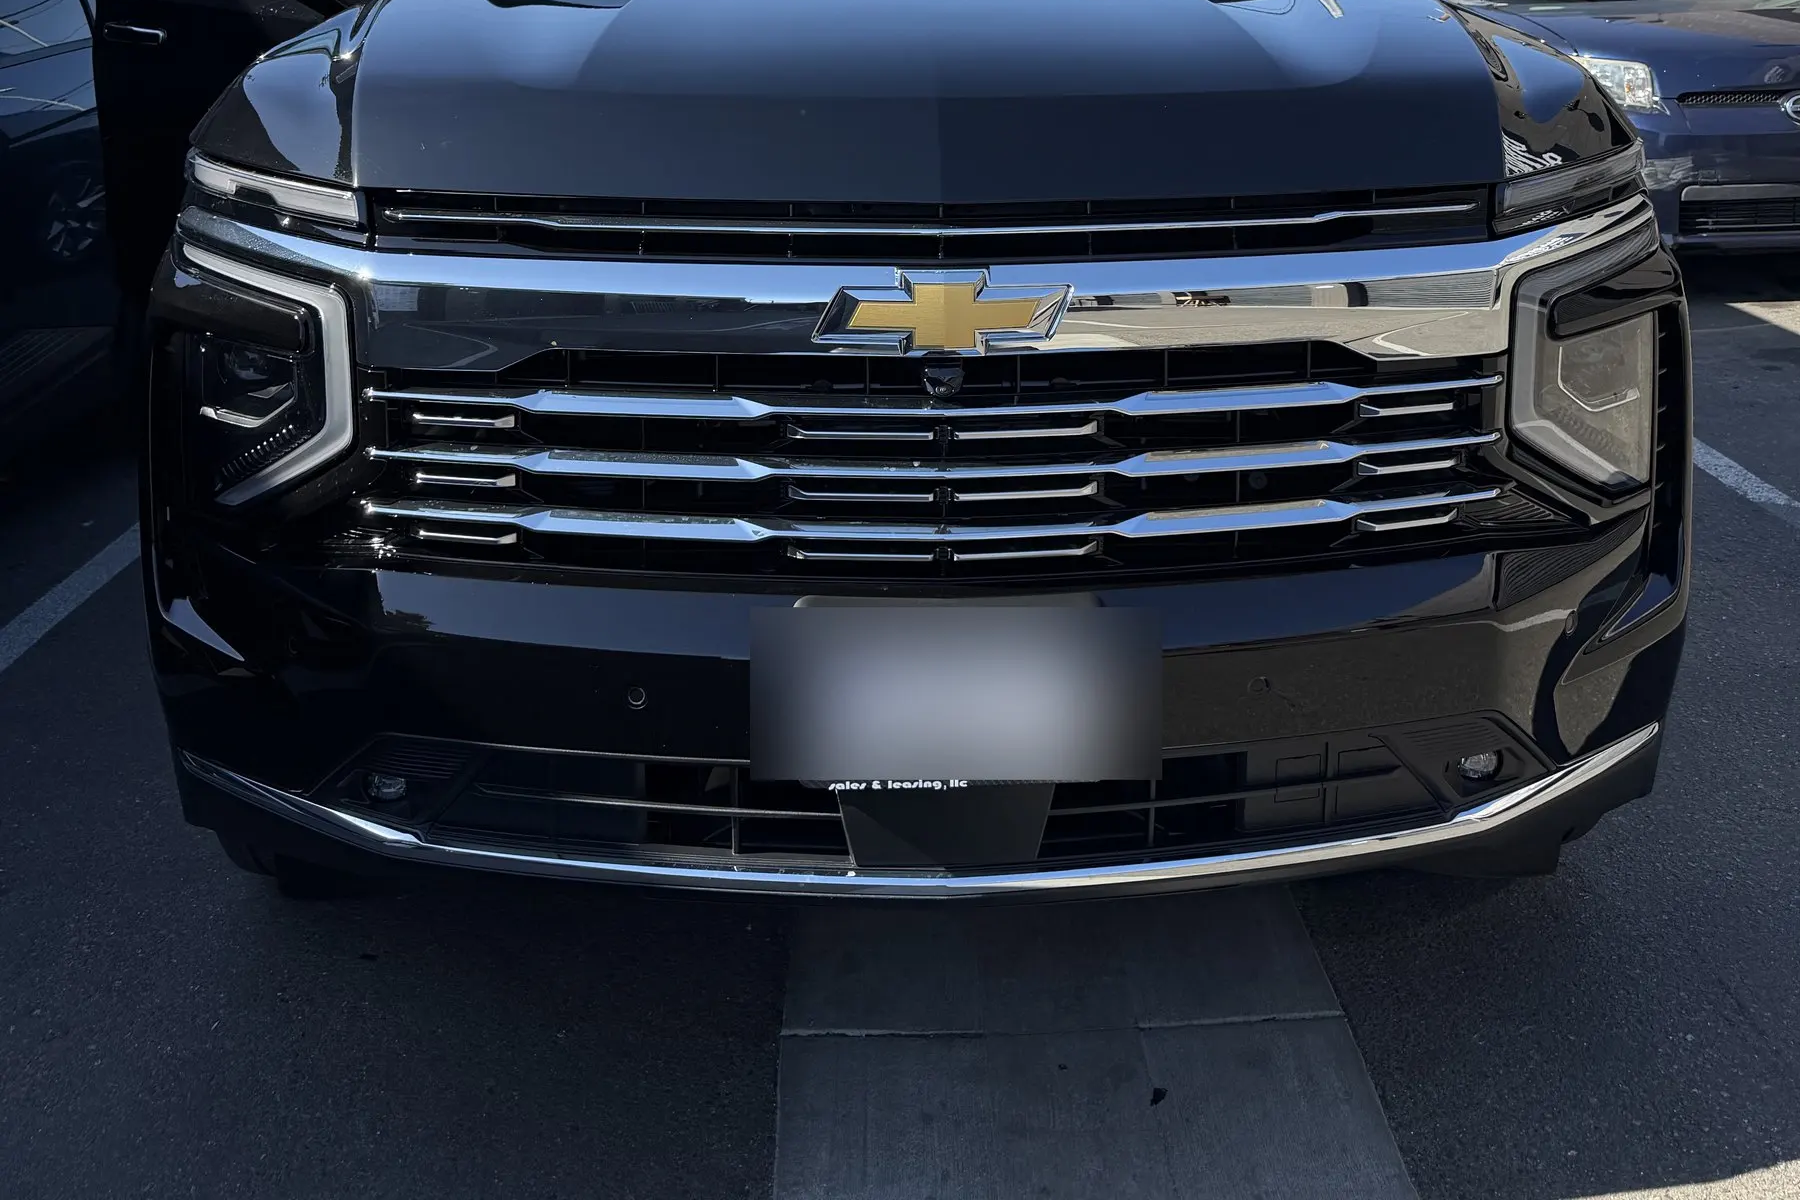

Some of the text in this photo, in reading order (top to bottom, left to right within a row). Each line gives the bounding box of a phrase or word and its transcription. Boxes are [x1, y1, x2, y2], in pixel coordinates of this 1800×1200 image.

[828, 779, 968, 791] sales & leasing, llc
